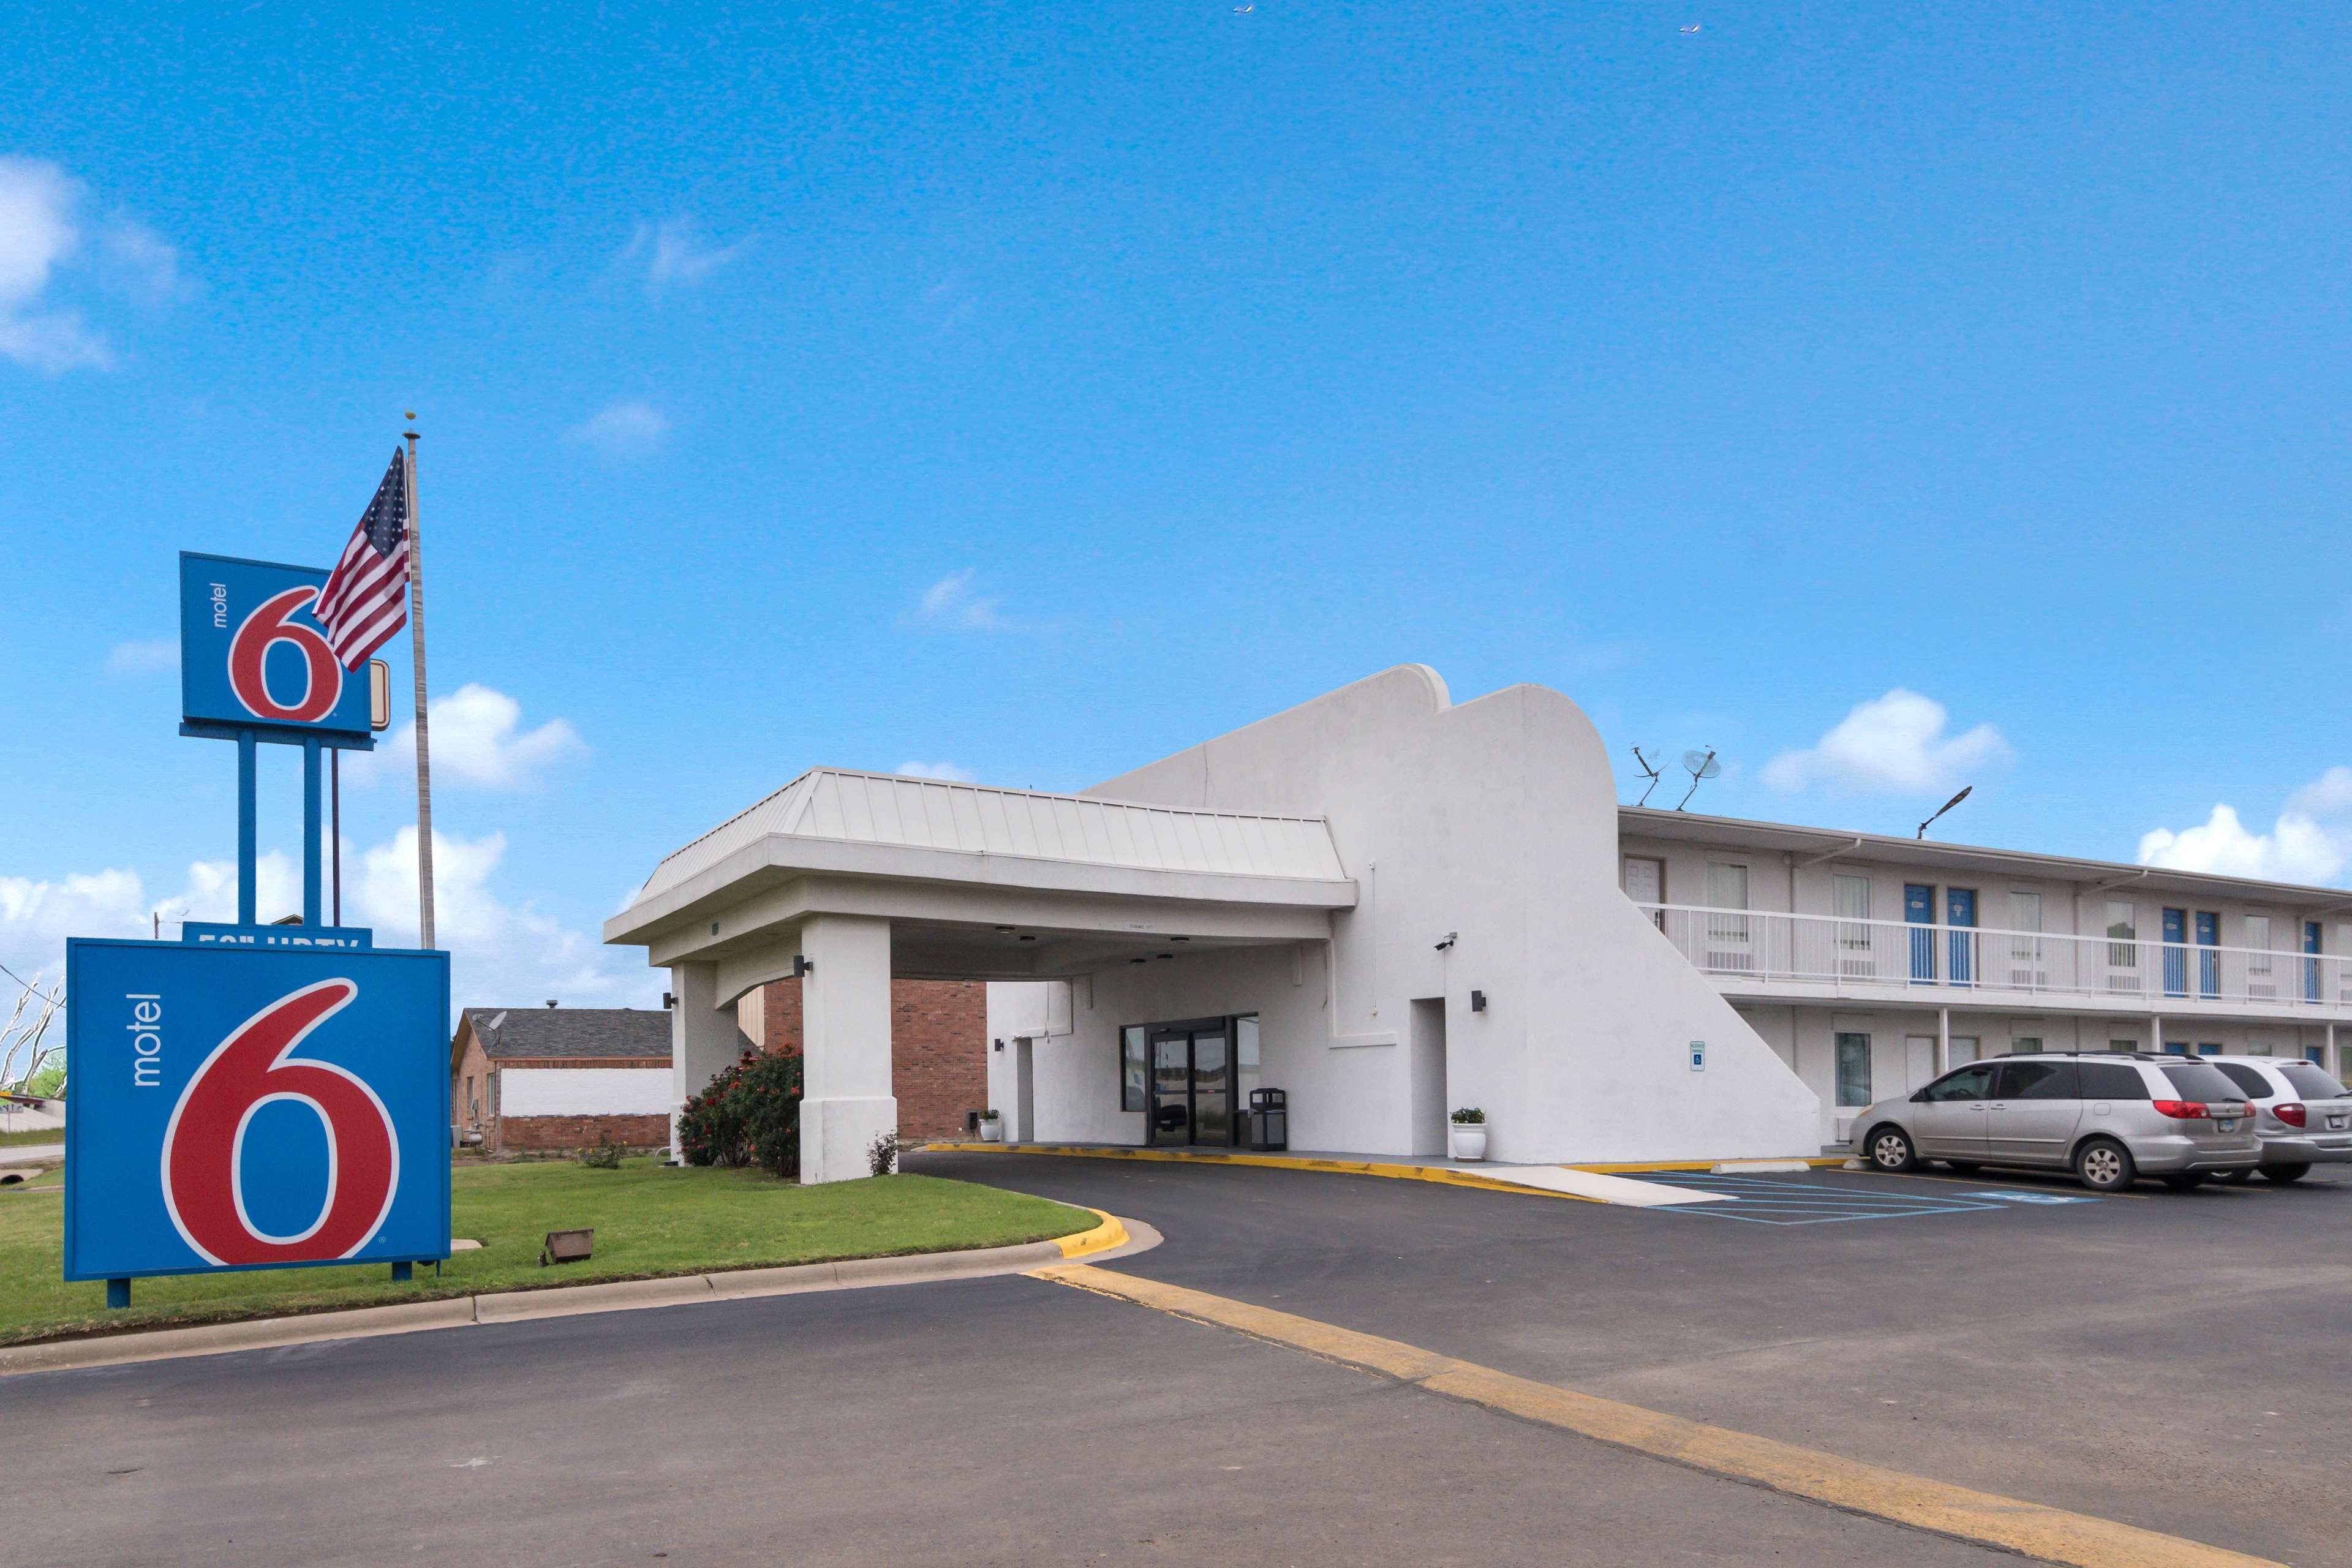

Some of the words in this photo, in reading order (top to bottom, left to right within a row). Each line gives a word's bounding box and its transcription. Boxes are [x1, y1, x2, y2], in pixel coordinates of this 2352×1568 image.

[209, 582, 227, 628] motel
[227, 585, 343, 722] 6
[126, 993, 161, 1086] motel
[160, 978, 400, 1266] 6
